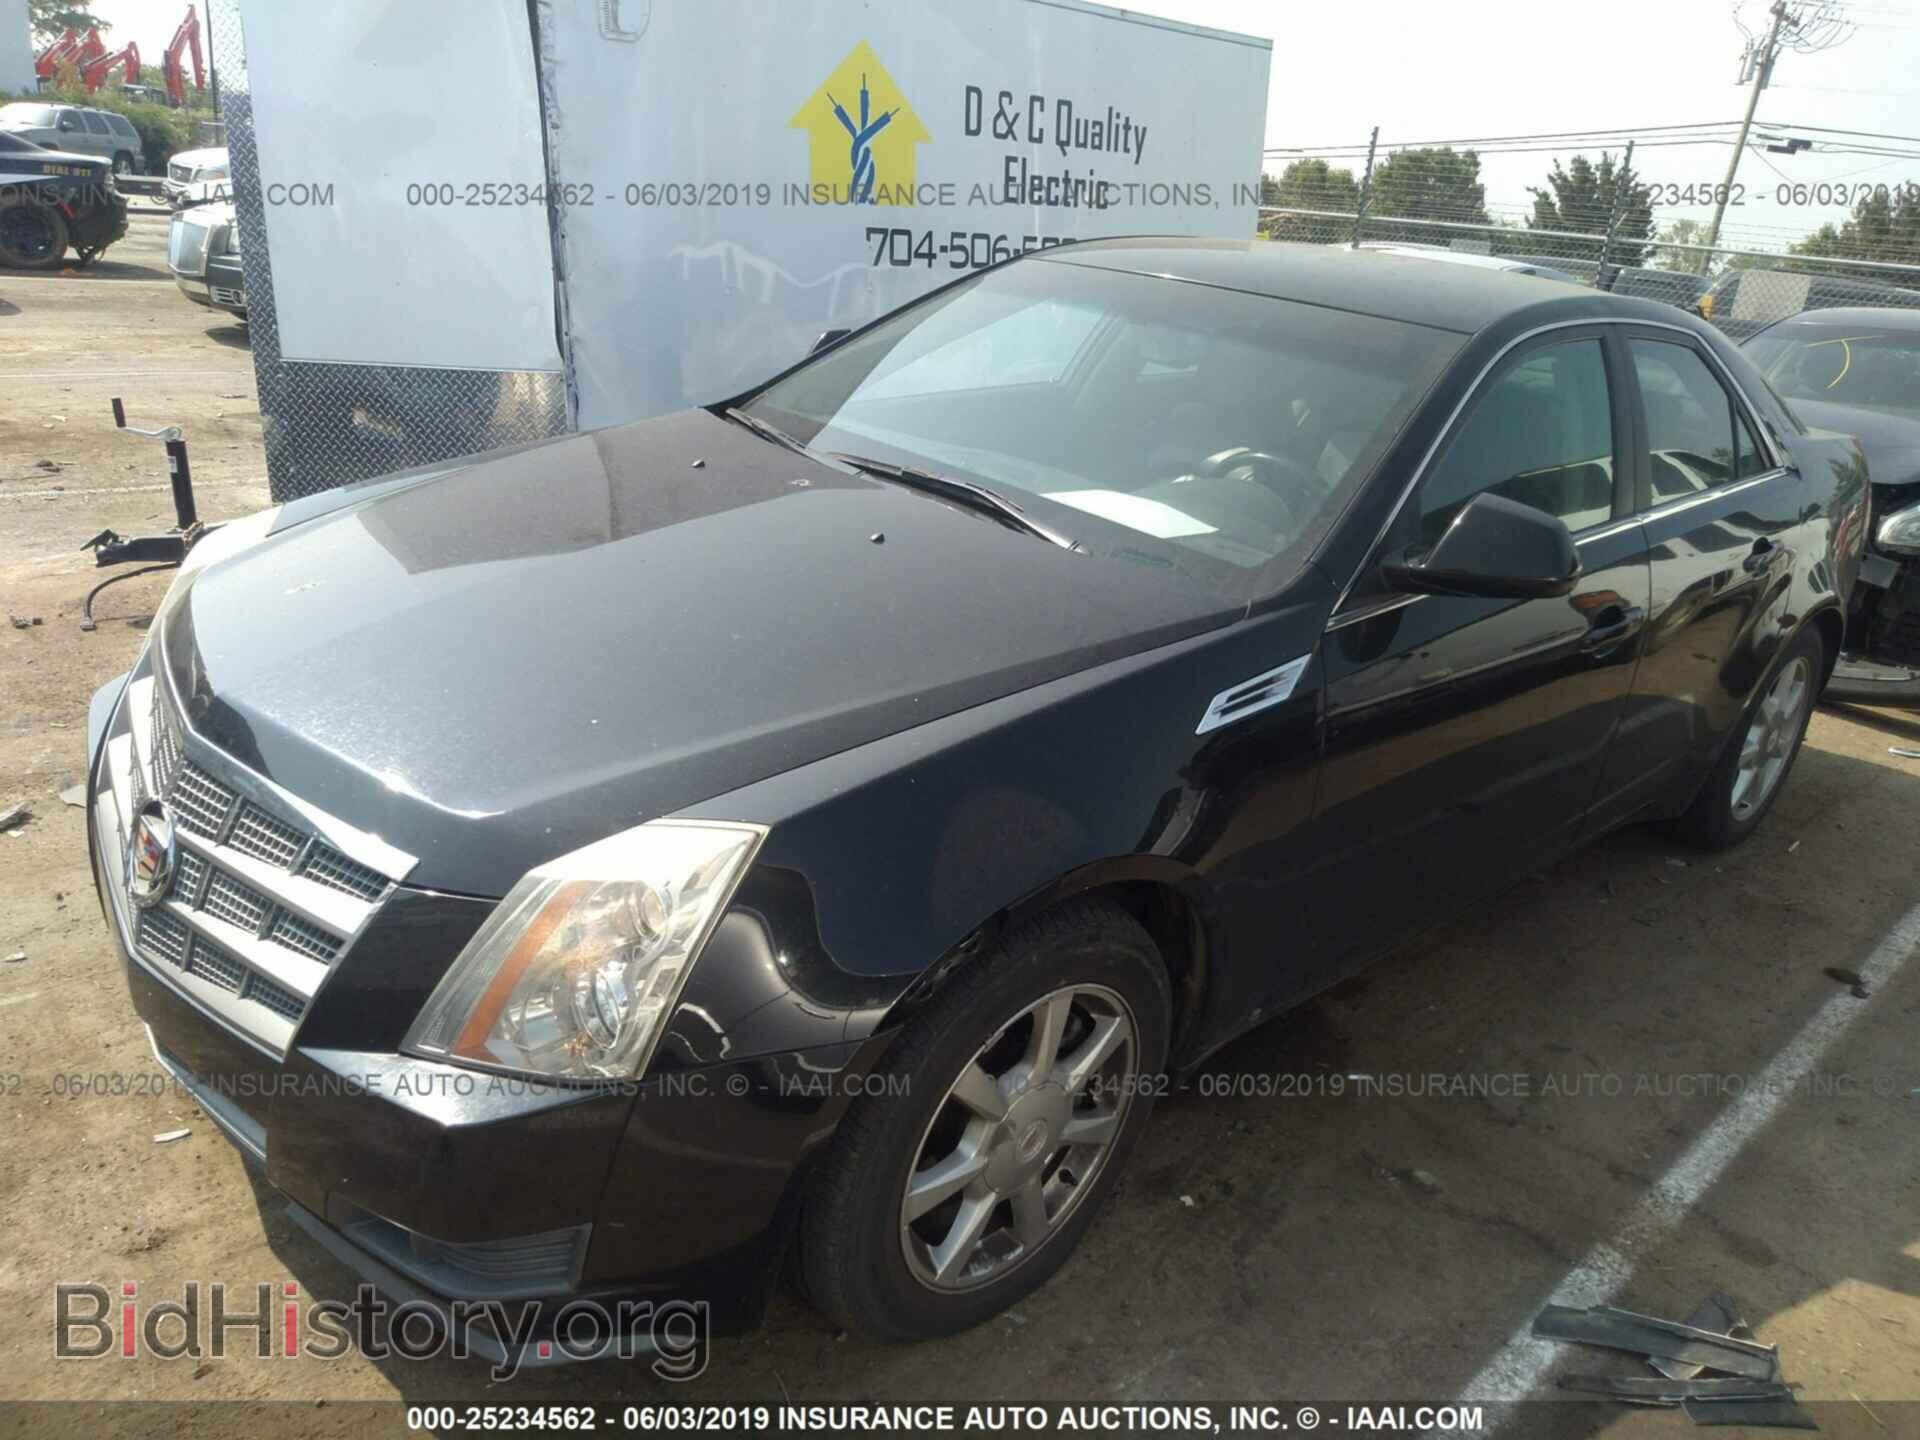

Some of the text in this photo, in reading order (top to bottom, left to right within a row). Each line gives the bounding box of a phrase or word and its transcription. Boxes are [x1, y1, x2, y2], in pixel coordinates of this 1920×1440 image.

[965, 85, 1147, 164] D & C Quality
[1005, 155, 1110, 211] Electric
